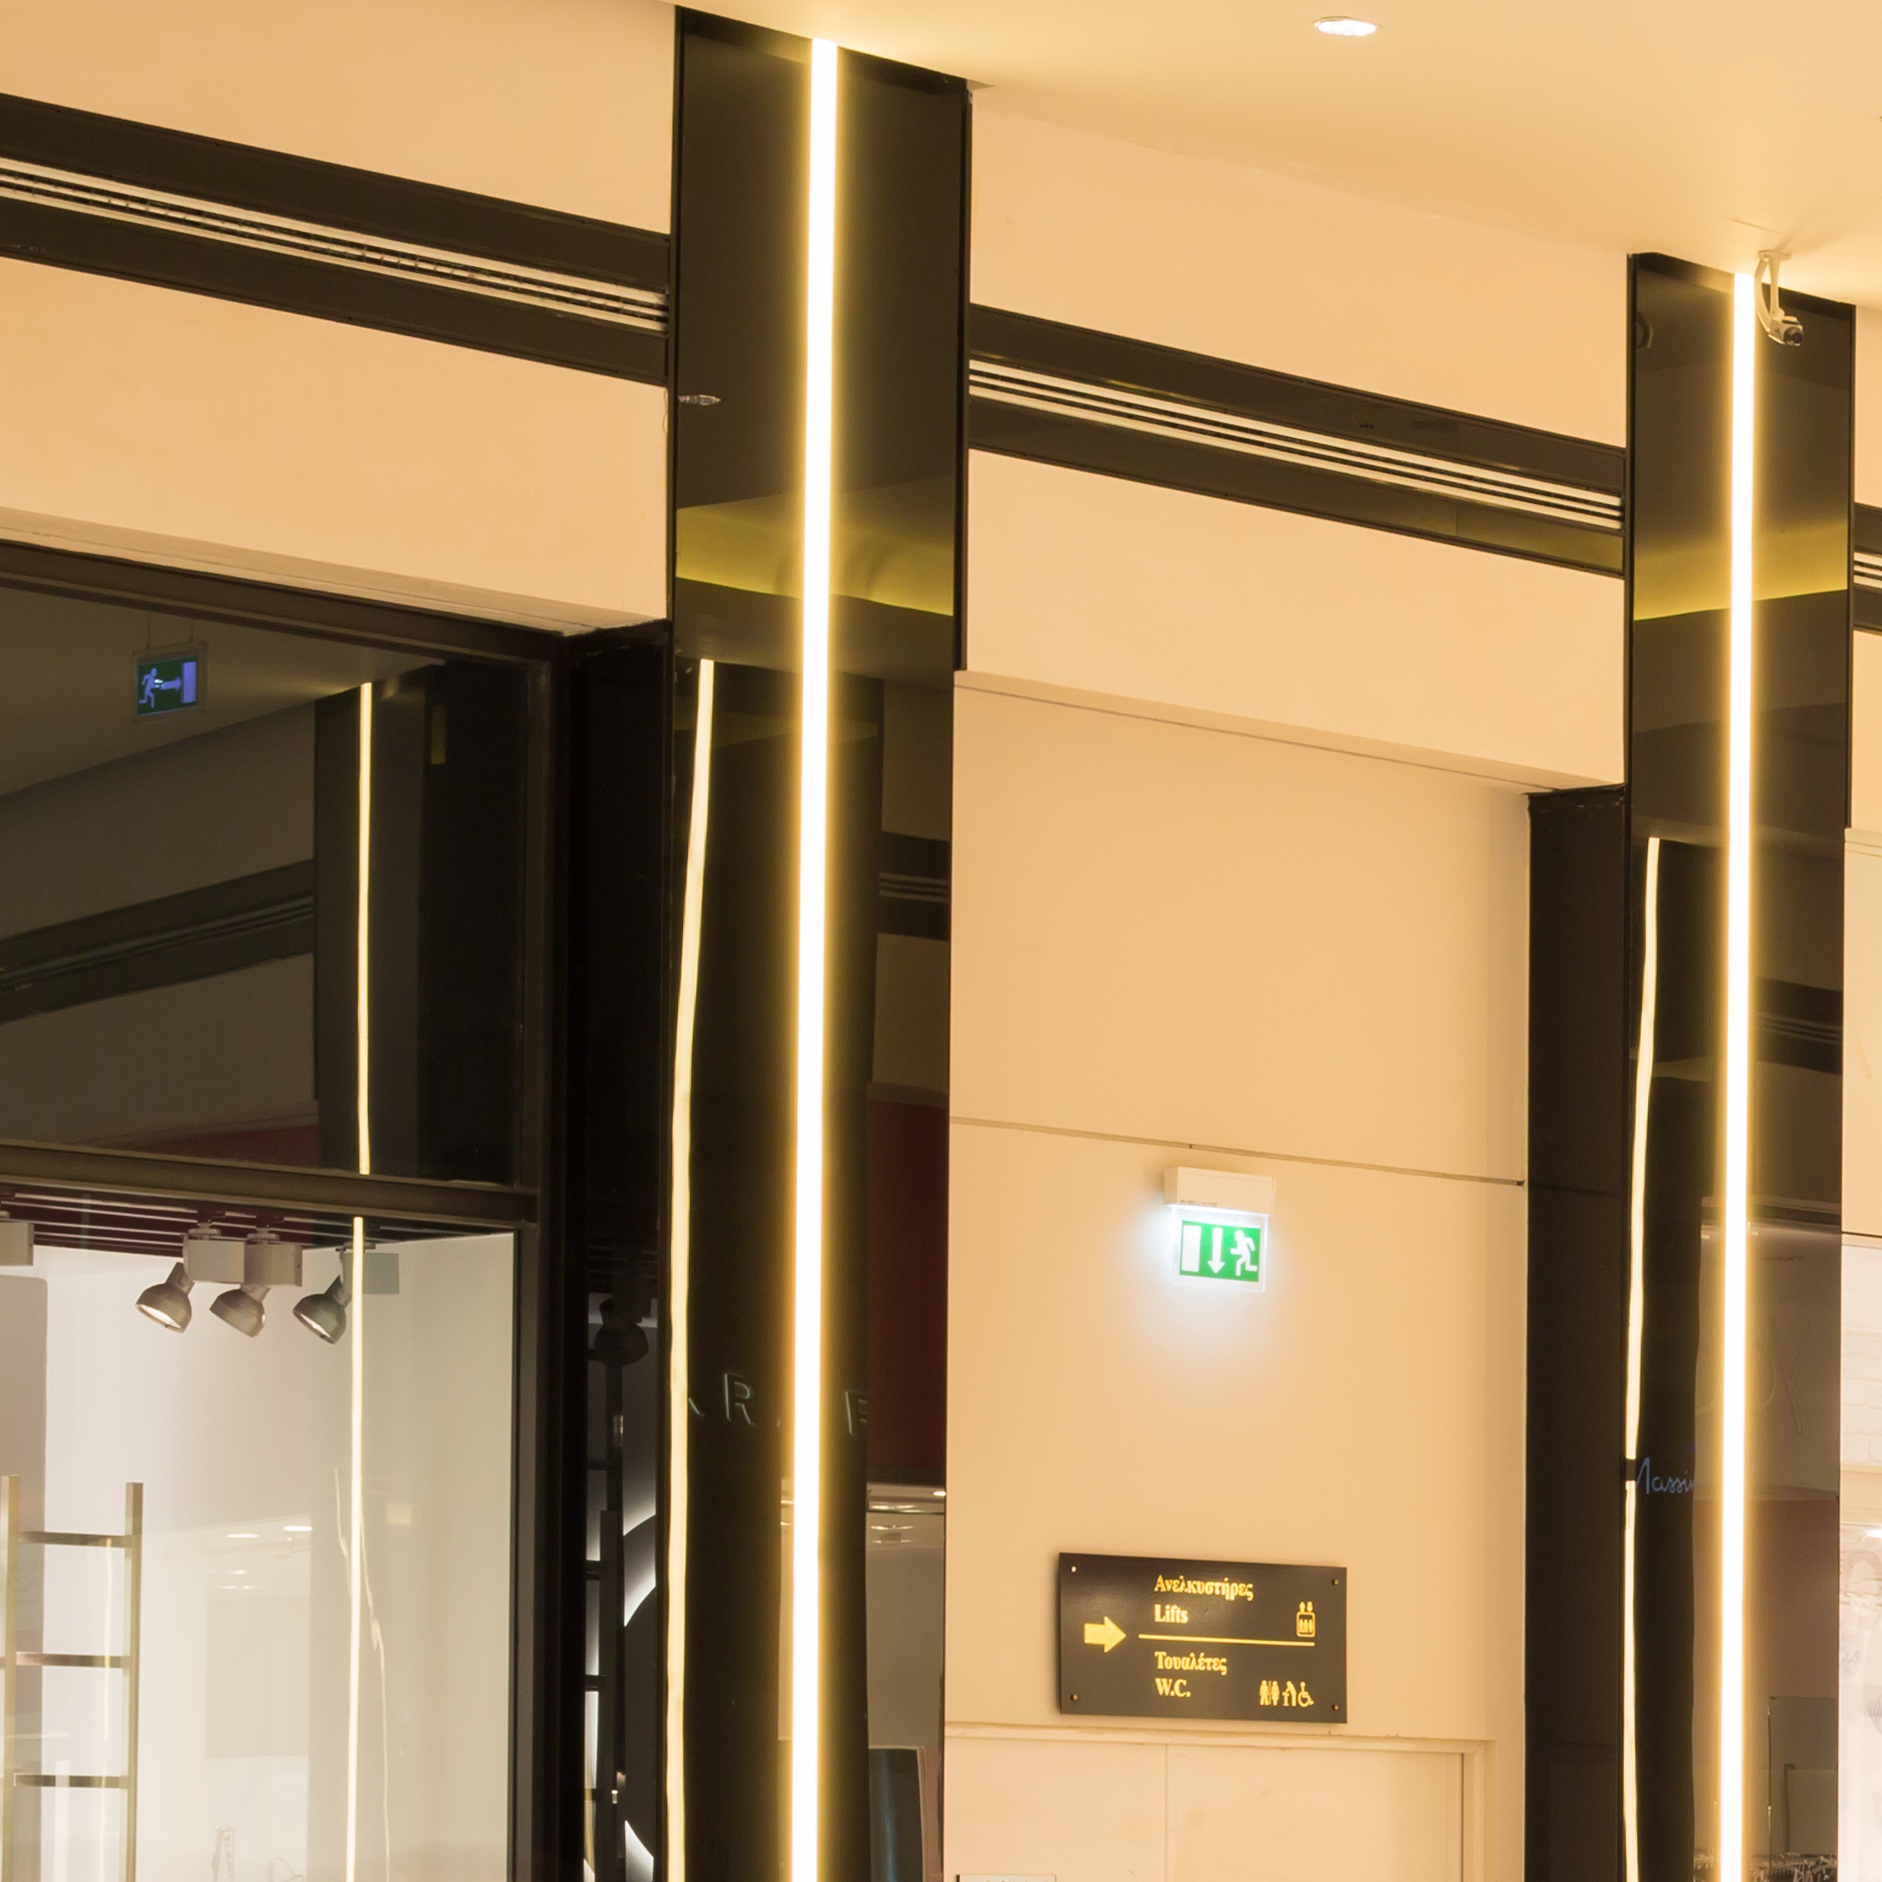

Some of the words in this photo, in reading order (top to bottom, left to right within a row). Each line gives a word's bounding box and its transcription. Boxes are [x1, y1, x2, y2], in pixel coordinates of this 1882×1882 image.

[1154, 1574, 1254, 1601] Ανελκυστήρες
[1154, 1604, 1189, 1624] Lifts
[1154, 1651, 1228, 1675] Τουαλέτες
[1155, 1678, 1192, 1698] W.C.
